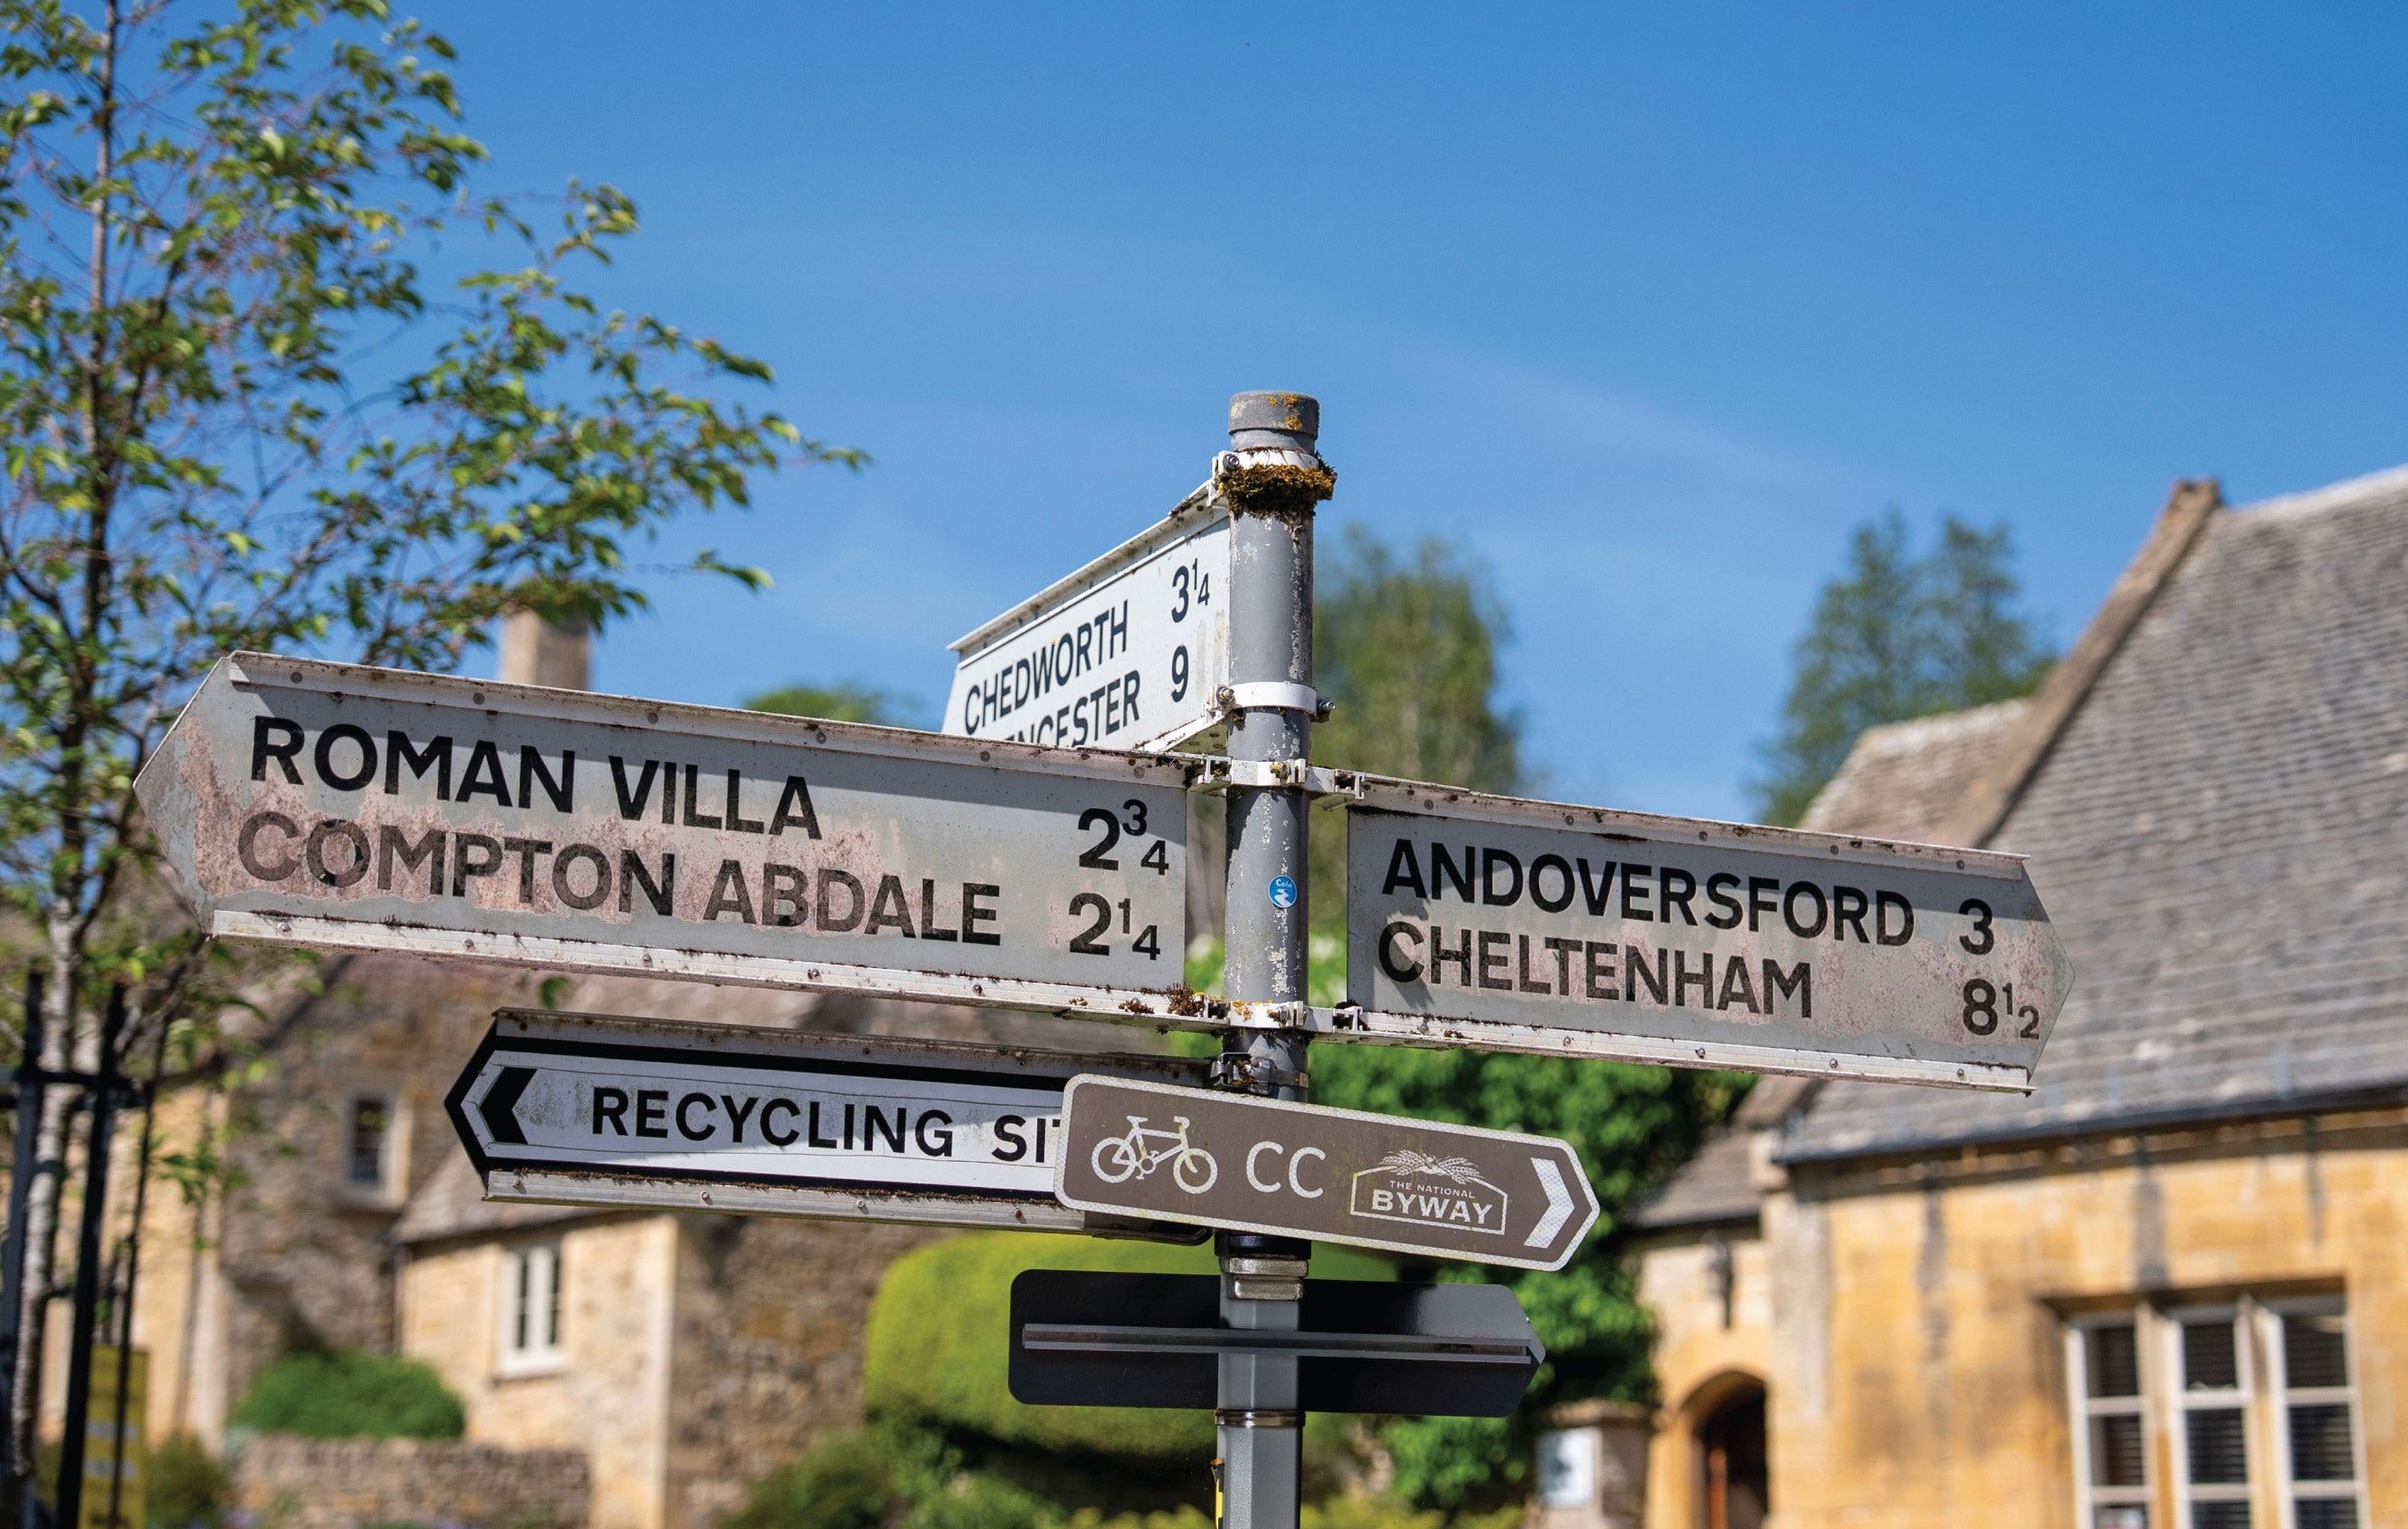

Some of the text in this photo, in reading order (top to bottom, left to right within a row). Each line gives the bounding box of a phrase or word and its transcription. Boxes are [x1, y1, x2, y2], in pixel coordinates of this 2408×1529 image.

[964, 599, 1129, 736] CHEDWORTH
[1004, 645, 1190, 747] CESTER 9
[250, 714, 575, 815] ROMAN
[608, 755, 823, 840] VILLA
[237, 810, 676, 917] COMPTON
[702, 859, 1001, 947] ABDALE
[1381, 838, 1995, 956] ANDOVERSFORD 3
[1377, 920, 1813, 1019] CHELTENHAM
[591, 1085, 1061, 1164] RECYCLING SI
[1245, 1140, 1327, 1199] CC
[1372, 1189, 1493, 1224] BYWAY
[1390, 1180, 1476, 1199] THE NATIONAL
